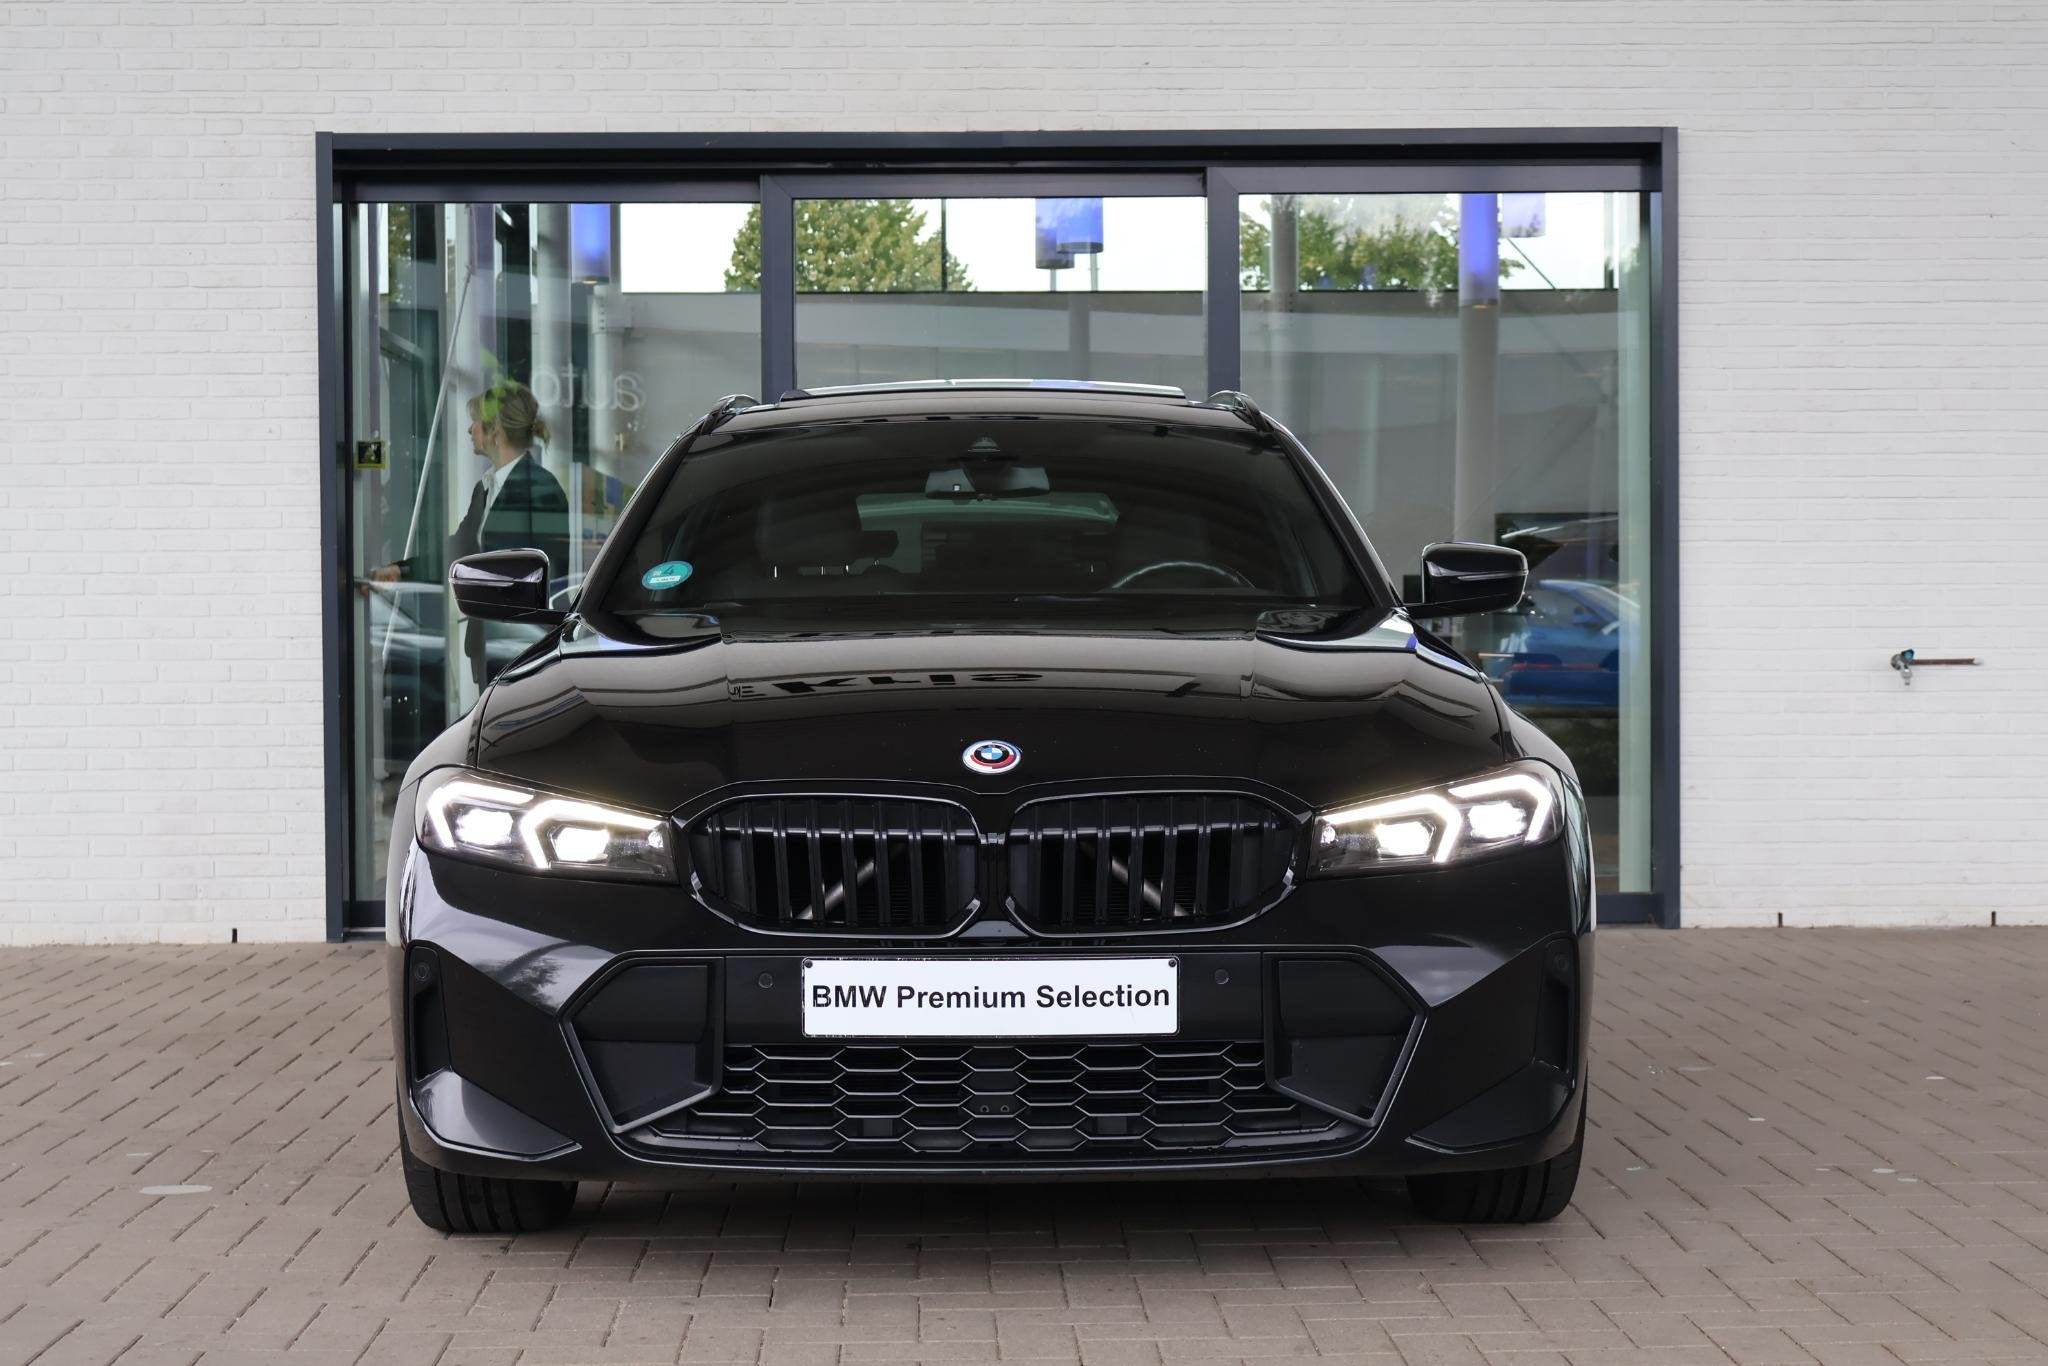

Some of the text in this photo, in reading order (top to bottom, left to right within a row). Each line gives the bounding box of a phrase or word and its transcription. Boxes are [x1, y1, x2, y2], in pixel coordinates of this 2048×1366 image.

[812, 983, 1170, 1009] BMW Premium Selection
